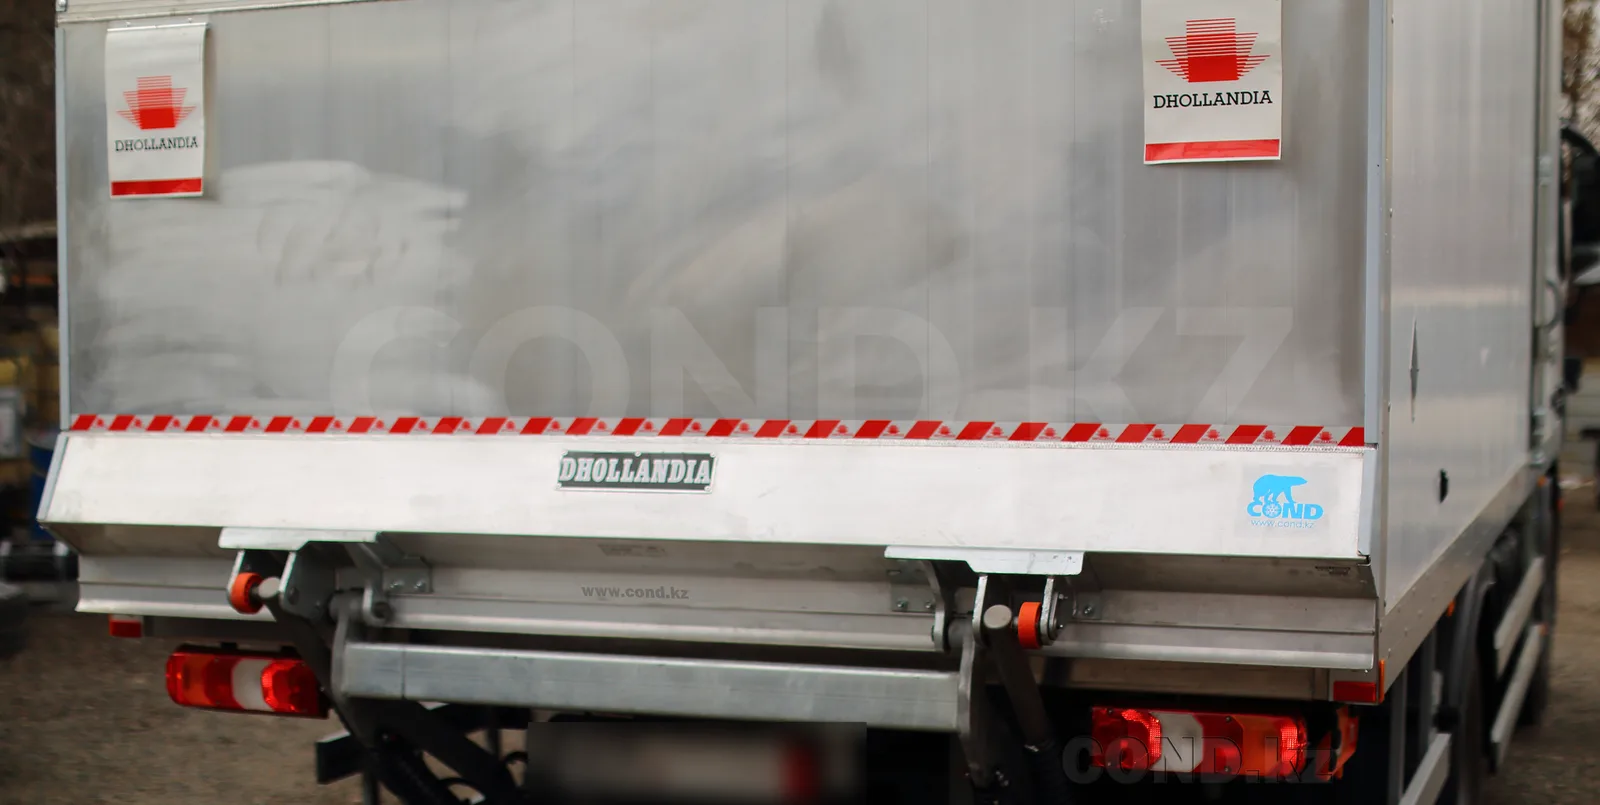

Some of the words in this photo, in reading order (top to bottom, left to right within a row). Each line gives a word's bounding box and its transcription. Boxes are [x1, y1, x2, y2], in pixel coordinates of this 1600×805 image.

[1153, 90, 1273, 108] DHOLLANDIA
[115, 136, 199, 151] DHOLLANDIA
[559, 457, 711, 483] DHOLLANDIA
[1246, 501, 1324, 520] COND
[1251, 520, 1314, 529] www.cond.kz
[581, 586, 690, 599] www.cond.kz
